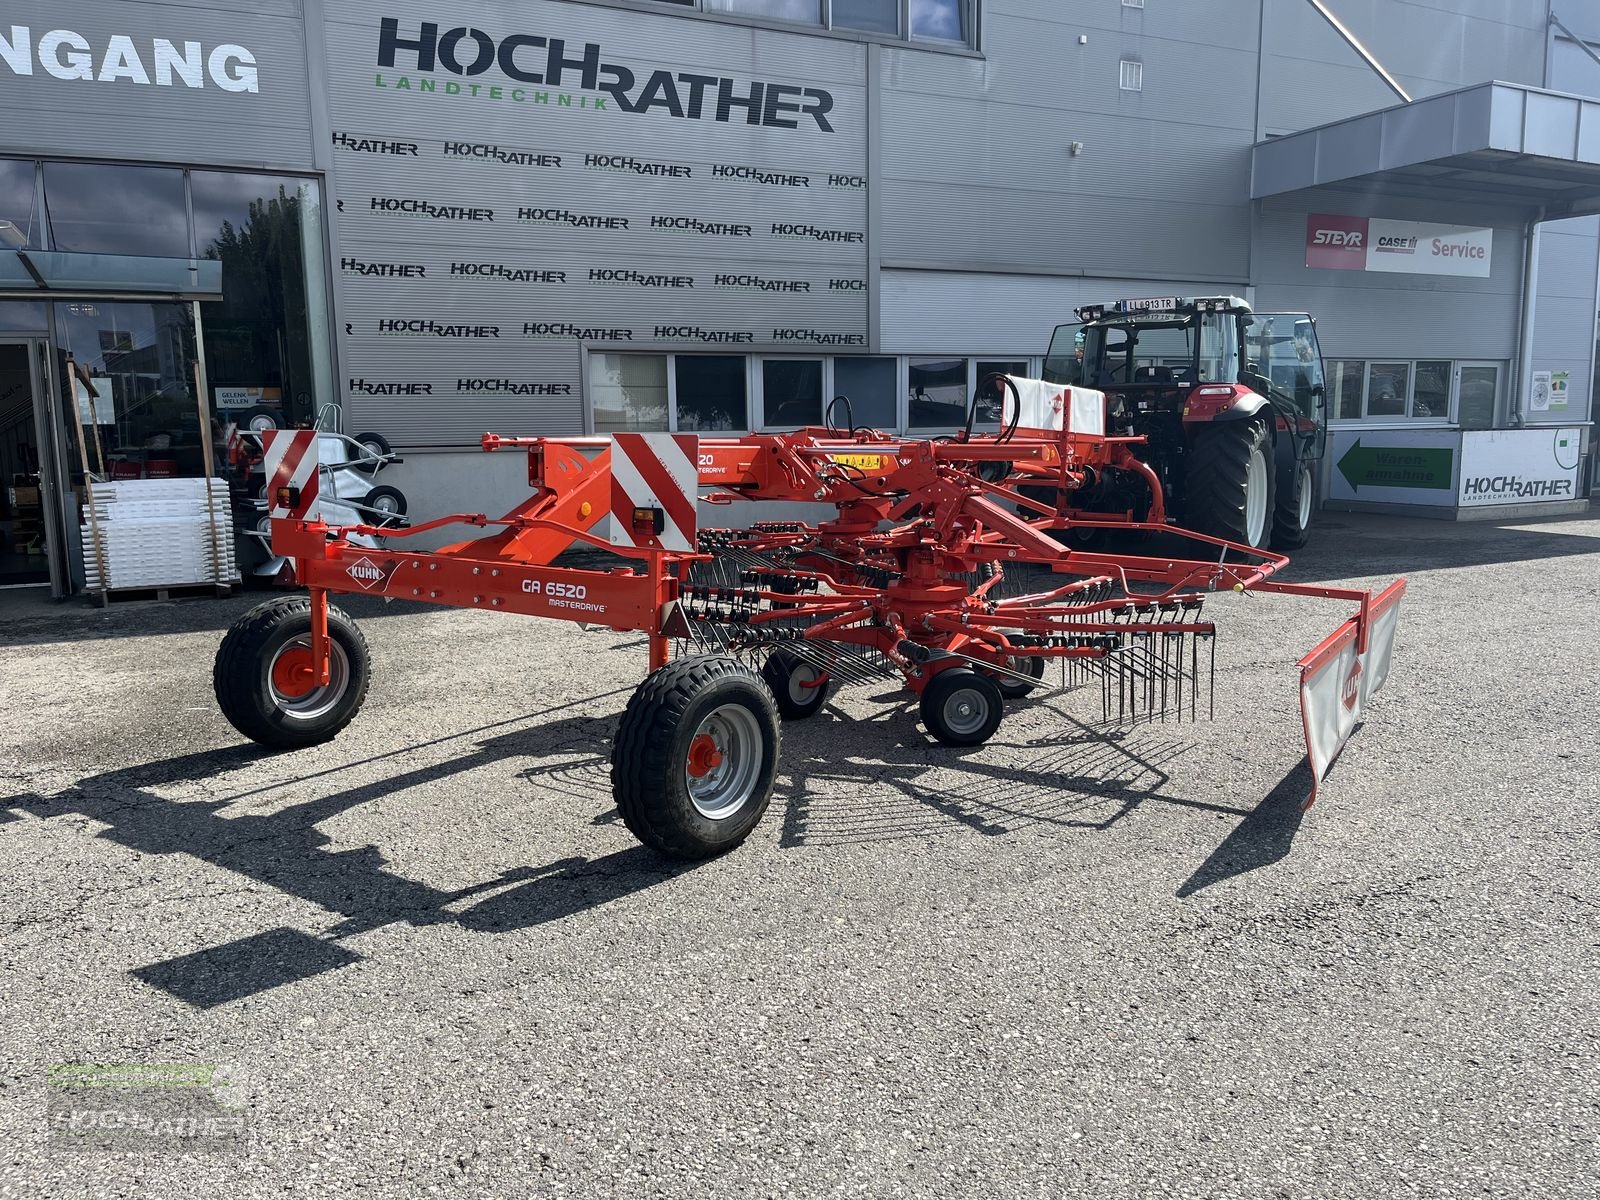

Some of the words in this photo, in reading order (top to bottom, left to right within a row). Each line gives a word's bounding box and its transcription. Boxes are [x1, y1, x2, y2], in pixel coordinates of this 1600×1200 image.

[377, 17, 835, 133] HOCHRATHER
[375, 74, 608, 110] LANDTECHNIK
[444, 141, 562, 168] HOCHRATHER
[584, 154, 692, 178] HOCHRATHER
[712, 164, 810, 187] HOCHRATHER
[371, 197, 494, 222] HOCHRATHER
[518, 207, 629, 230] HOCHRATHER
[650, 215, 752, 237] HOCHRATHER
[771, 223, 864, 243] HOCHRATHER
[1313, 229, 1362, 247] STEYR
[1378, 236, 1407, 248] CASE
[1432, 238, 1485, 259] Service
[450, 262, 567, 283] HOCHRATHER
[588, 268, 694, 288] HOCHRATHER
[714, 274, 811, 292] HOCHRATHER
[1145, 300, 1159, 309] 913
[1161, 299, 1171, 308] TR
[379, 319, 500, 338] HOCHRATHER
[523, 323, 632, 341] HOCHRATHER
[654, 325, 754, 343] HOCHRATHER
[772, 328, 864, 345] HOCHRATHER
[457, 379, 571, 395] HOCHRATHER
[1464, 476, 1571, 497] HOCHRATHER
[1463, 493, 1516, 501] LANDTECHNIK
[351, 566, 380, 580] KUHN
[521, 579, 541, 594] GA
[545, 581, 587, 600] 6520
[548, 599, 606, 613] MASTERDRIVE
